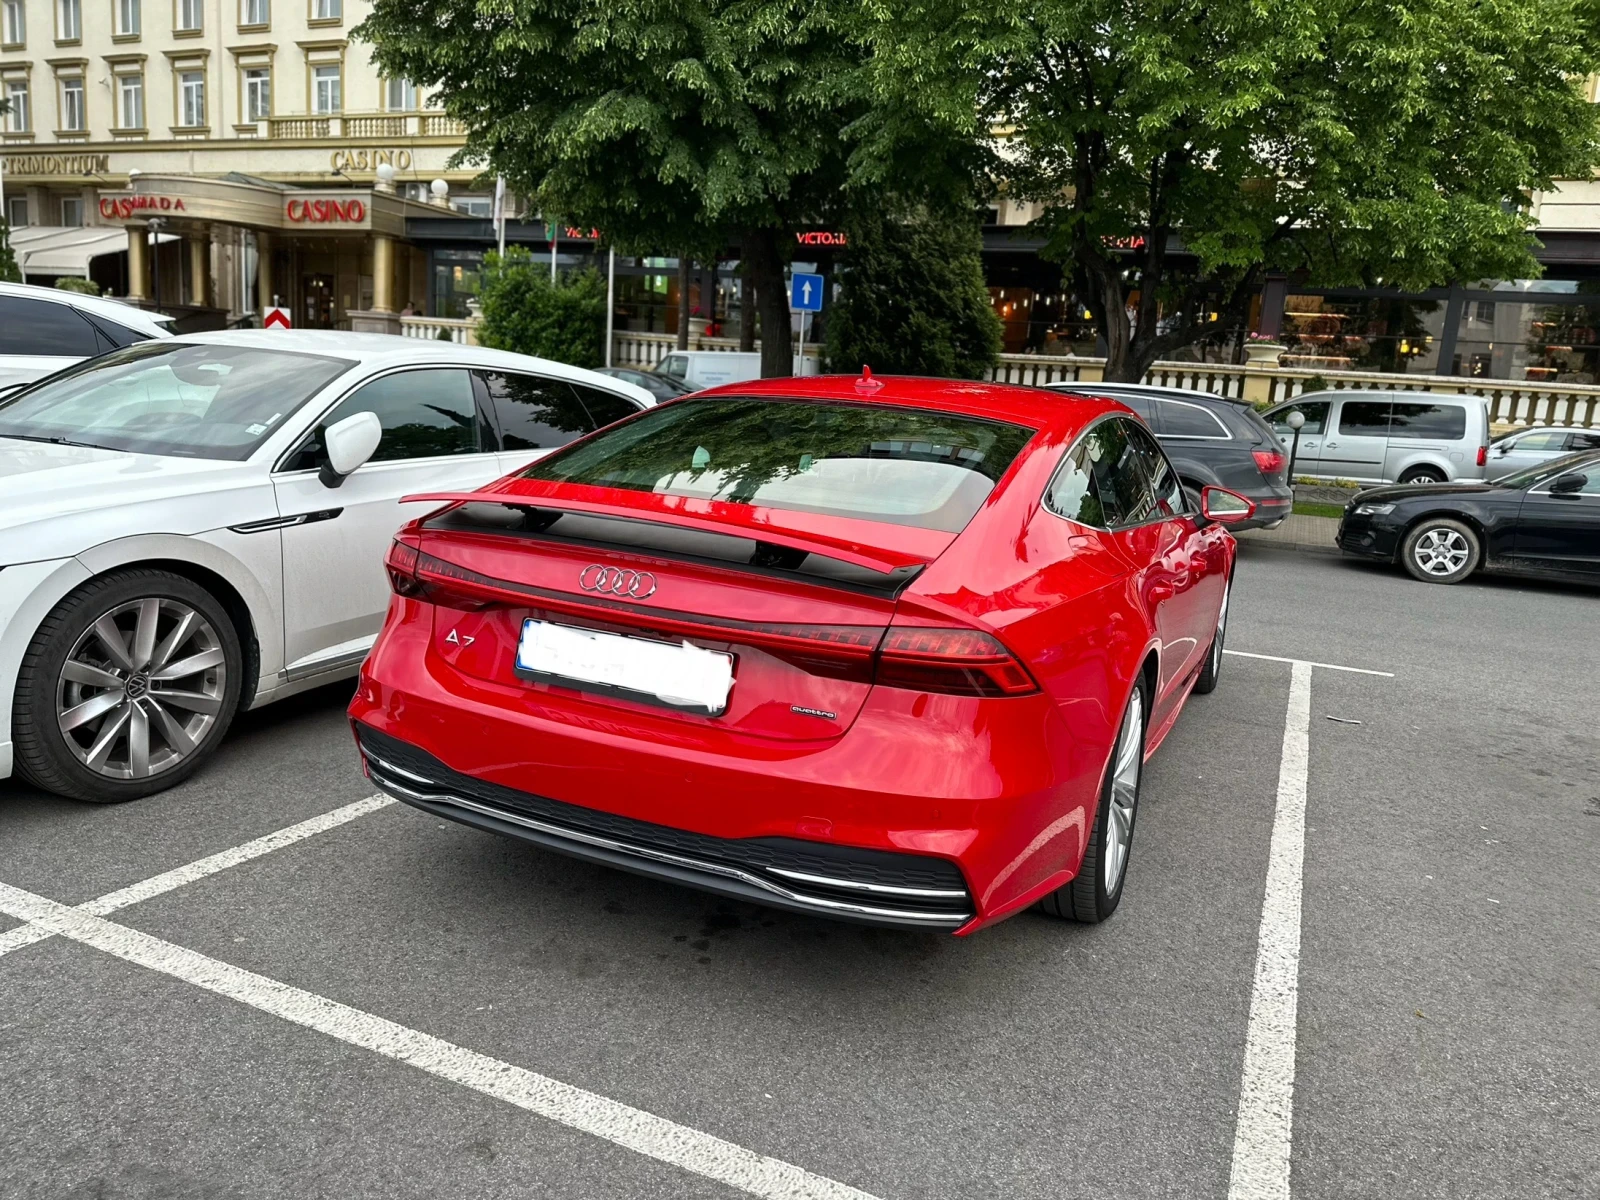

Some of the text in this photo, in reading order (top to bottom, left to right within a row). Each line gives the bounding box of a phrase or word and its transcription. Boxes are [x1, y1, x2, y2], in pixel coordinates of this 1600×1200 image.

[7, 155, 110, 175] TRIMONTIUM
[330, 150, 412, 171] CASINO
[99, 198, 132, 219] CAS
[287, 199, 365, 222] CASINO
[445, 628, 475, 647] A7
[792, 705, 835, 718] quattro
